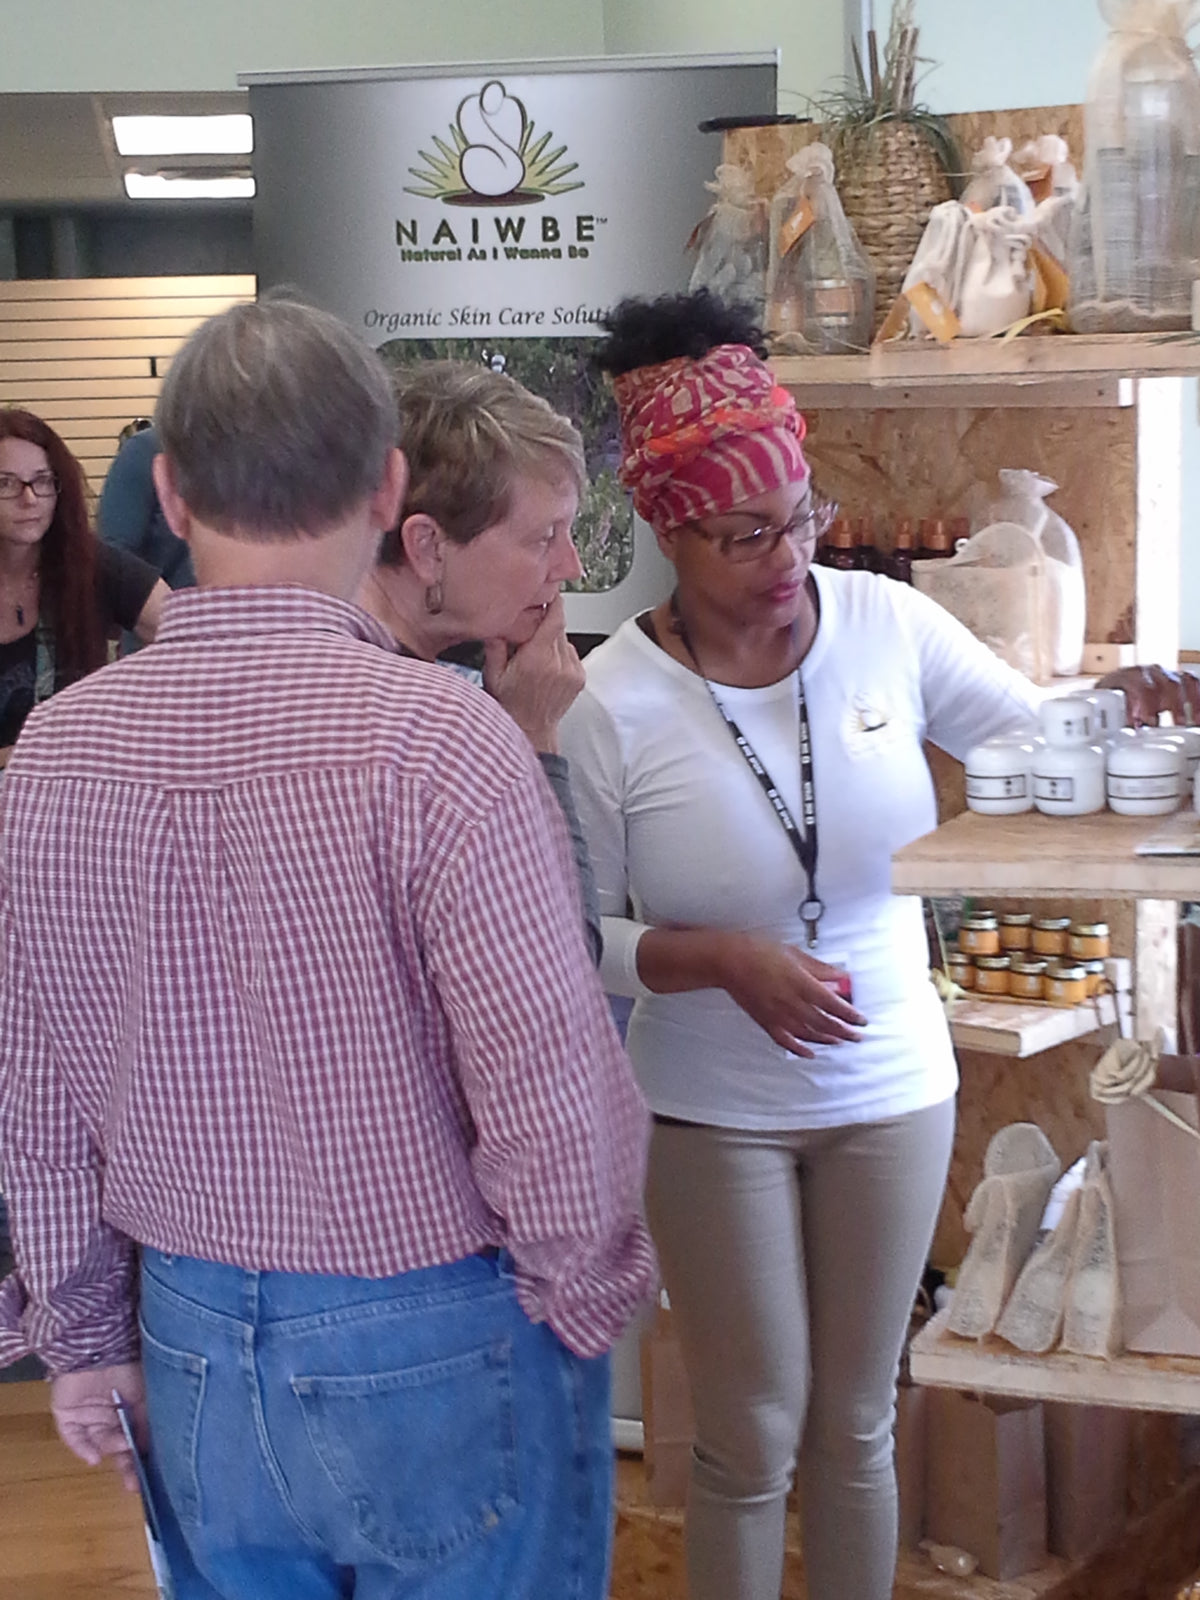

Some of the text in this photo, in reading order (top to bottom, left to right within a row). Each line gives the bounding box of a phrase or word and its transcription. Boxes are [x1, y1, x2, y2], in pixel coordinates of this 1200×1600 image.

[396, 215, 595, 247] NAIWBE
[401, 245, 590, 263] Natural As I Wanna Be
[363, 303, 611, 333] Organic Skin Care Soluti
